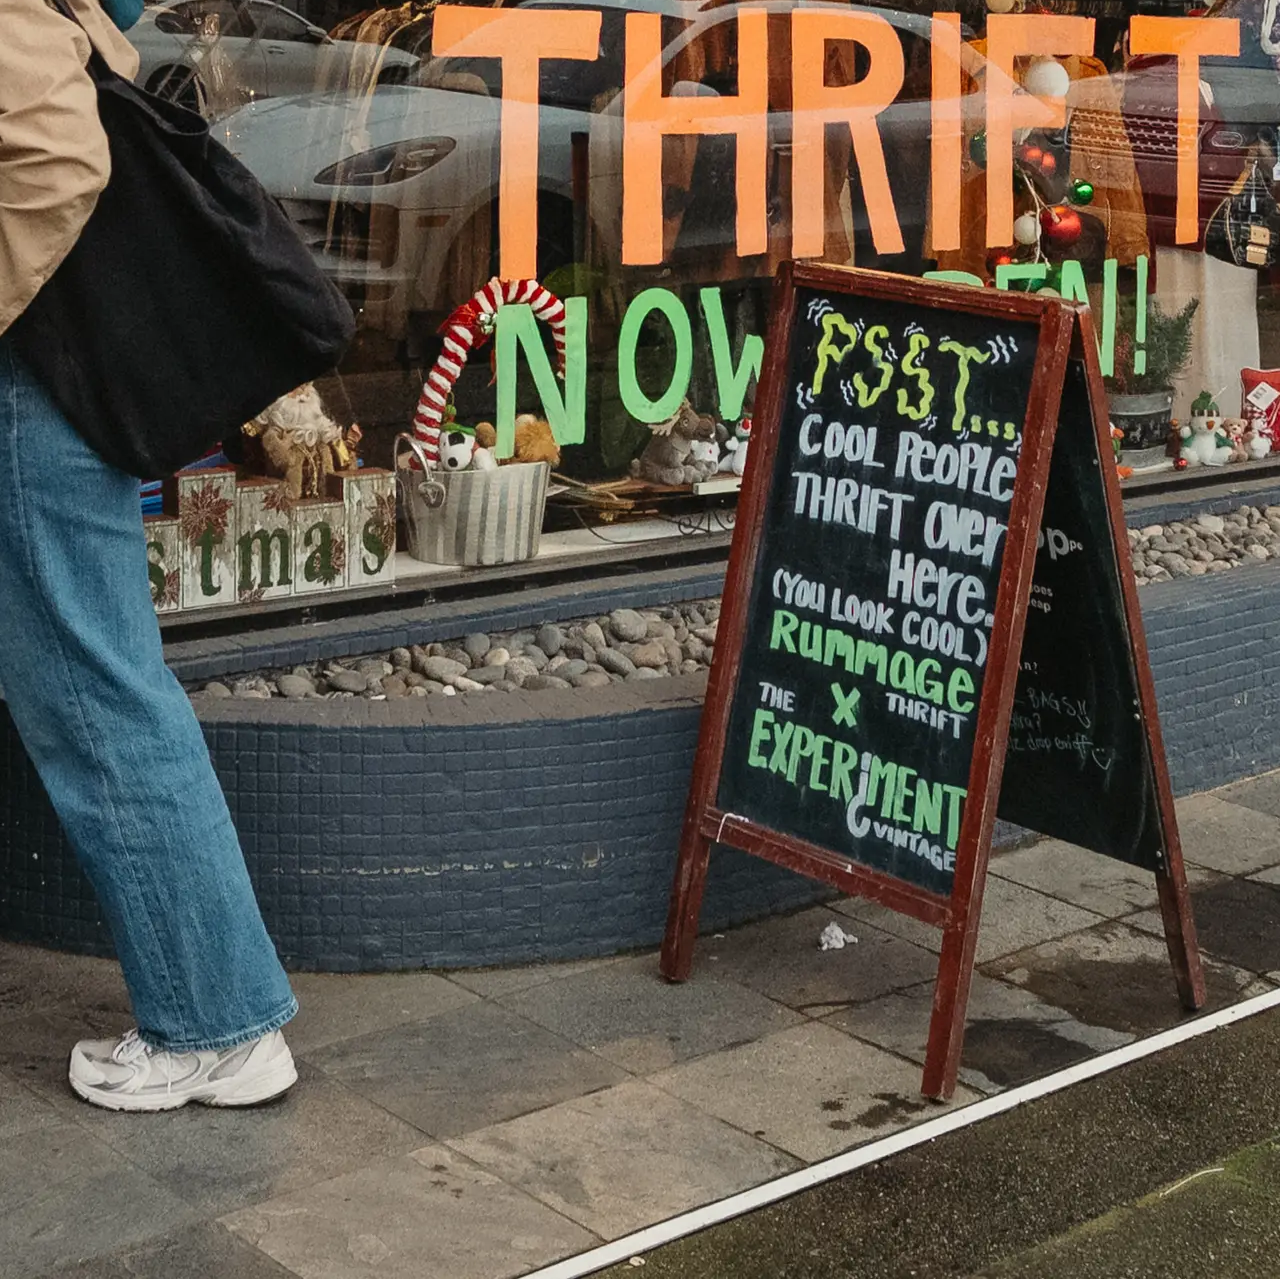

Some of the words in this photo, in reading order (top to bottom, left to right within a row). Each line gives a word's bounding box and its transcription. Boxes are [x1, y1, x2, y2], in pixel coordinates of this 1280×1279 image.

[431, 6, 1240, 280] THRIFT
[495, 285, 764, 459] NOW
[798, 413, 885, 468] COOL
[792, 471, 915, 541] THRIFT
[772, 568, 826, 614] (YOU
[831, 588, 895, 635] LOOK
[902, 610, 988, 668] COOL)
[887, 548, 995, 627] Here.
[759, 681, 797, 713] THE
[885, 692, 969, 740] THRIFT
[831, 681, 861, 728] X
[872, 821, 957, 872] VINTAGE
